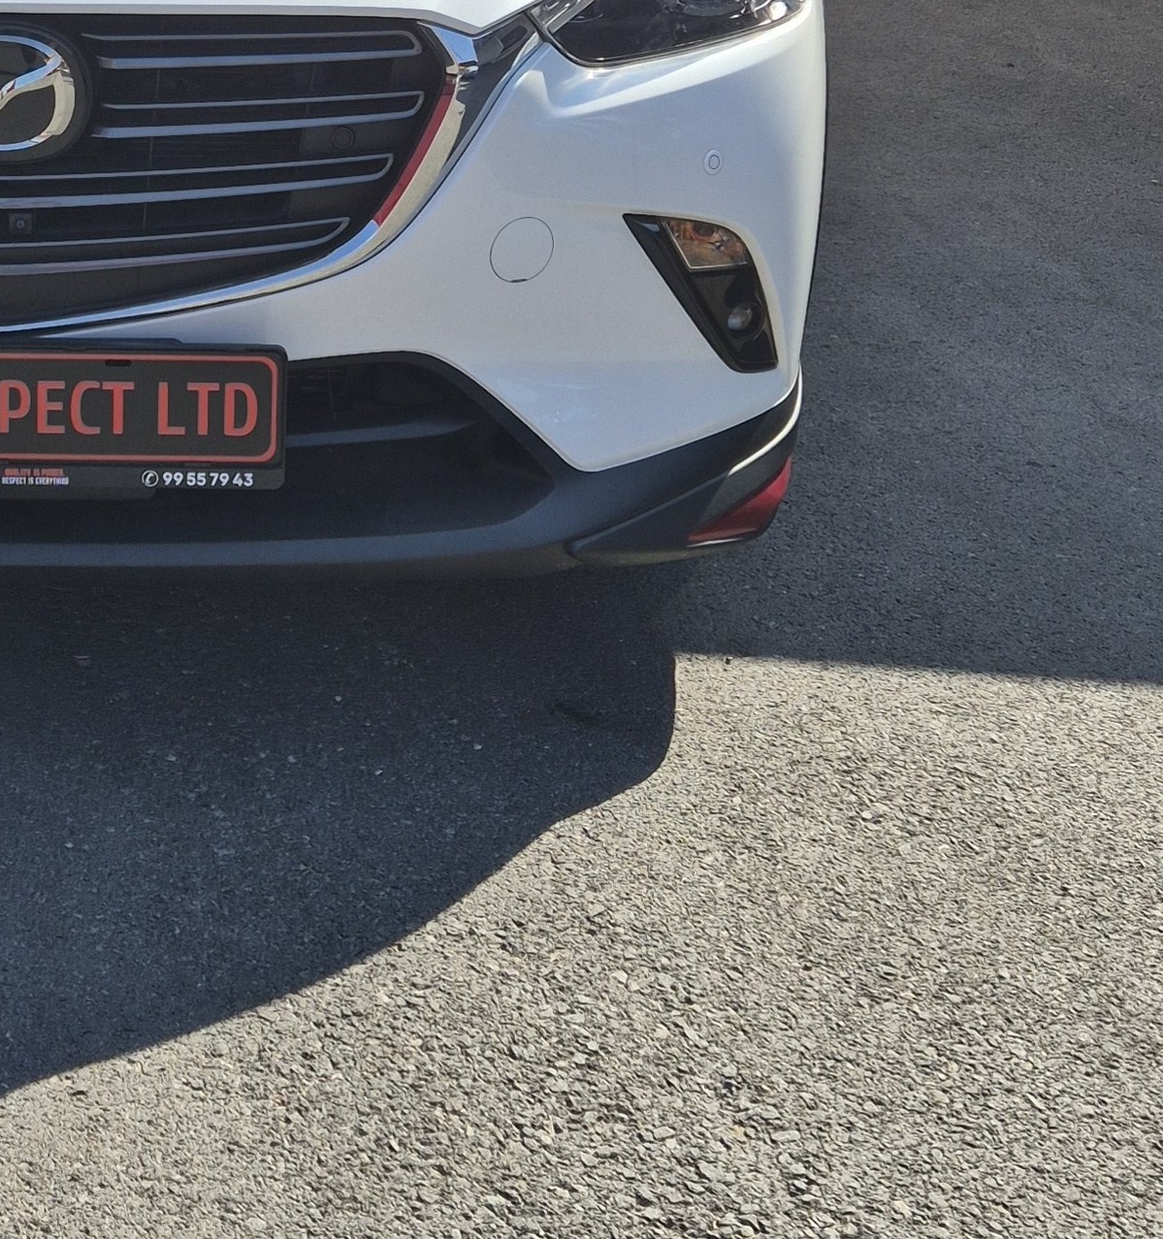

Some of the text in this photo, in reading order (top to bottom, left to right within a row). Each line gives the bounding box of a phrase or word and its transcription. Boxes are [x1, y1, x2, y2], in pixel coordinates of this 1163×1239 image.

[156, 381, 258, 437] LTD
[1, 476, 27, 485] RESPECT
[27, 476, 35, 485] IS
[162, 471, 254, 487] 99 55 79 43
